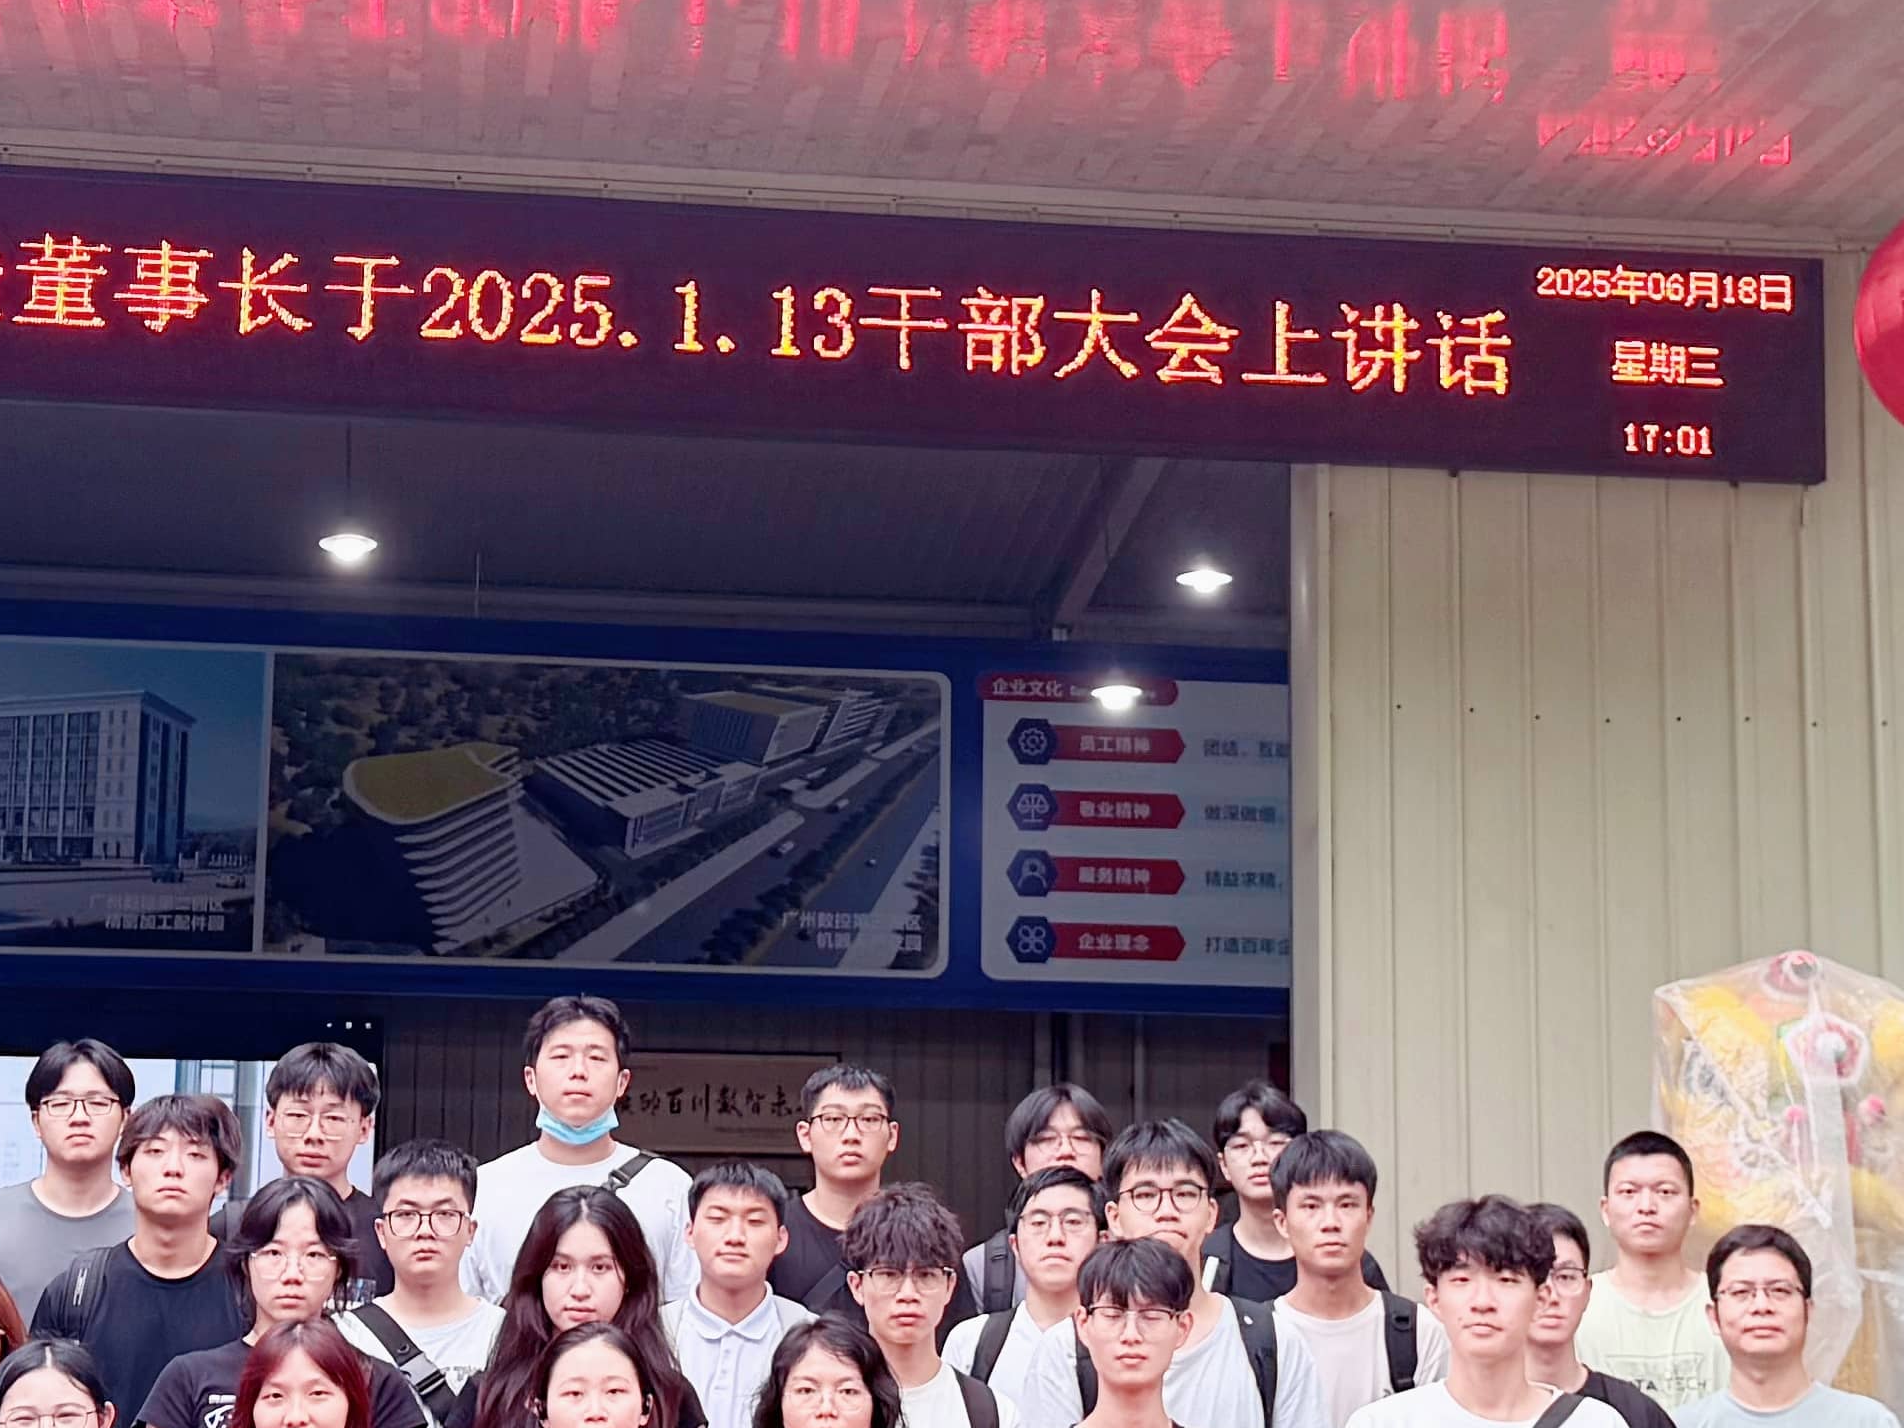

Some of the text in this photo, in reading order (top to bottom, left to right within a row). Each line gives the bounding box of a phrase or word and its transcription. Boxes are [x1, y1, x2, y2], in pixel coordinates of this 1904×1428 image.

[1534, 262, 1795, 317] 2025年06月18日
[1610, 338, 1725, 388] 星期三
[1621, 422, 1715, 458] 17:01
[992, 677, 1063, 698] 企业文化
[1079, 734, 1151, 754] 员工精神
[1078, 865, 1151, 885] 服务精神
[1078, 932, 1151, 952] 企业理念
